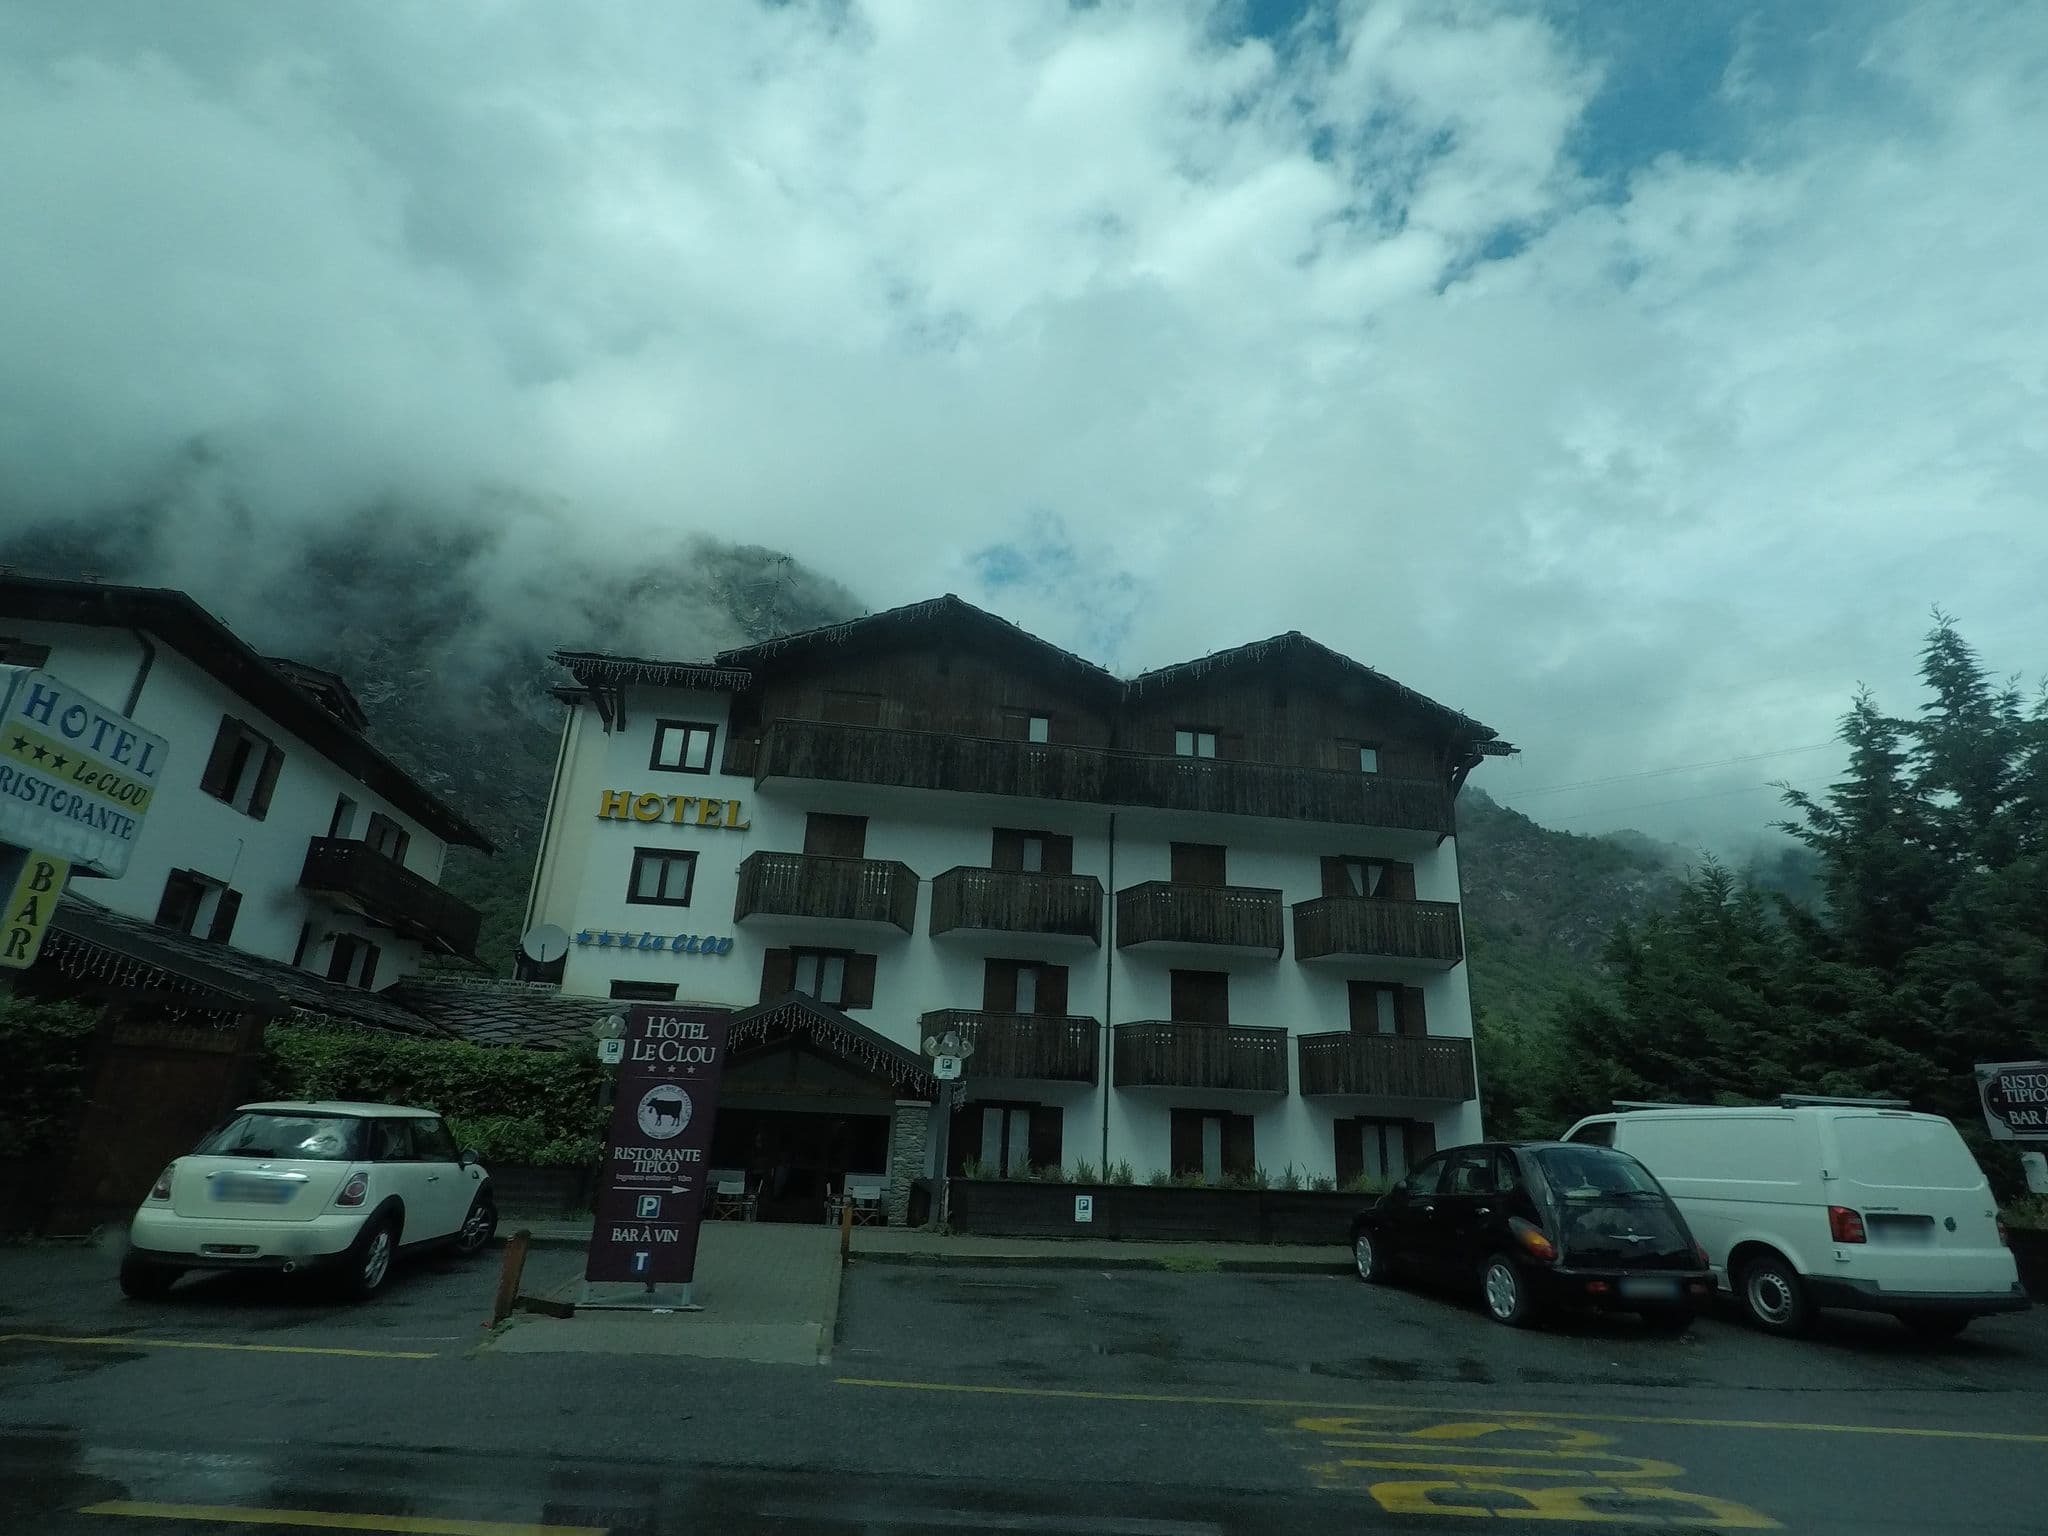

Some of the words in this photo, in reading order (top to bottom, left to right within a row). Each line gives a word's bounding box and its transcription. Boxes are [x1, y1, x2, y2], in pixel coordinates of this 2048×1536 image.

[22, 682, 155, 778] HOTEL
[72, 760, 97, 785] Le
[97, 773, 148, 806] CLOU
[0, 765, 136, 840] RISTORANTE
[598, 790, 751, 831] HOTEL
[3, 861, 56, 960] BAR
[638, 932, 665, 951] Le
[671, 933, 734, 955] CLOU
[645, 1016, 710, 1040] HÔTEL
[658, 1040, 717, 1064] CLOU
[2001, 1088, 2048, 1103] TIPIC
[2007, 1110, 2044, 1125] BAR
[613, 1146, 702, 1162] RISTORANTE
[632, 1160, 680, 1174] TIPICO
[641, 1197, 658, 1216] P
[611, 1227, 639, 1242] BAR
[640, 1225, 653, 1242] À
[654, 1229, 680, 1242] VIN
[1294, 1415, 1789, 1530] BUS
